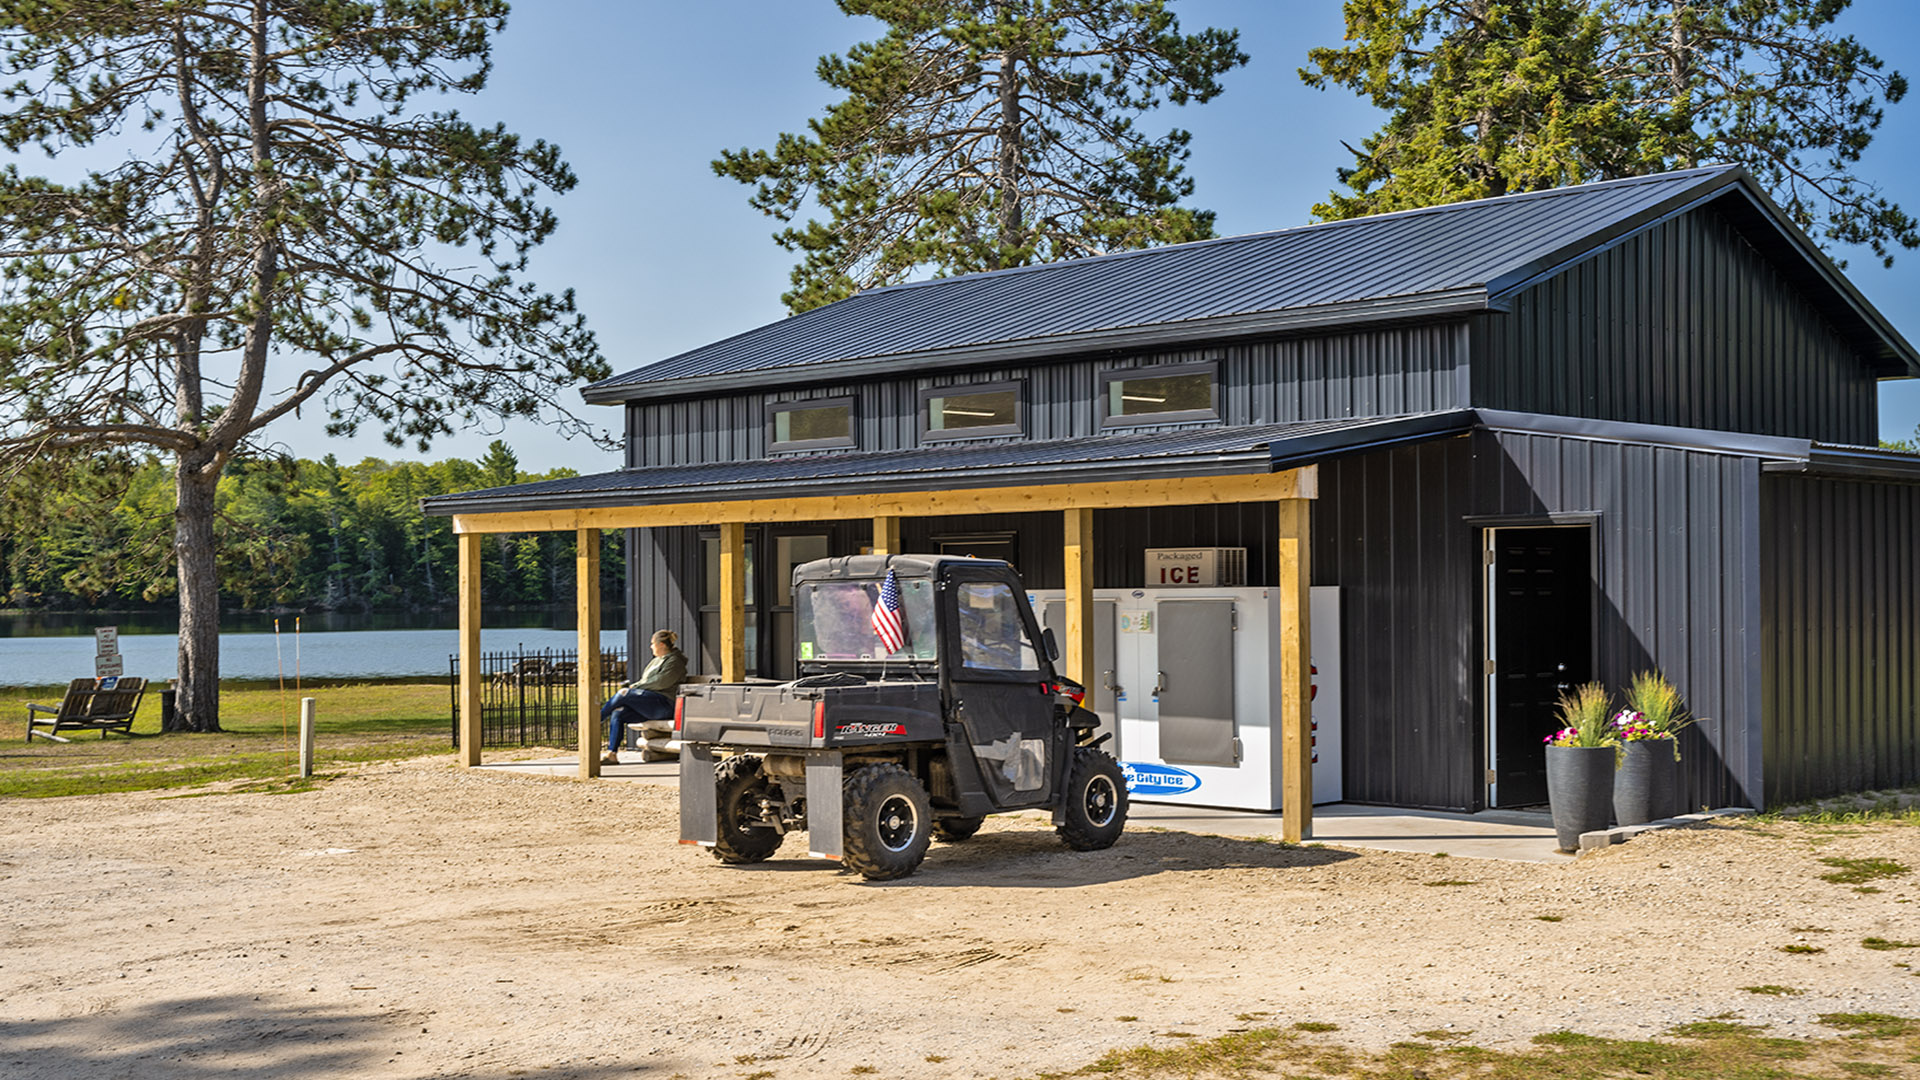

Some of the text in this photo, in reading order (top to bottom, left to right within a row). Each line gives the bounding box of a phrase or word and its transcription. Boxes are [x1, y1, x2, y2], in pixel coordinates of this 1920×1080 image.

[1157, 552, 1202, 561] Packaged
[1160, 566, 1200, 584] ICE
[768, 727, 804, 737] POLARIS
[840, 722, 898, 735] RANGER
[1136, 773, 1161, 785] City
[1163, 775, 1184, 785] Ice
